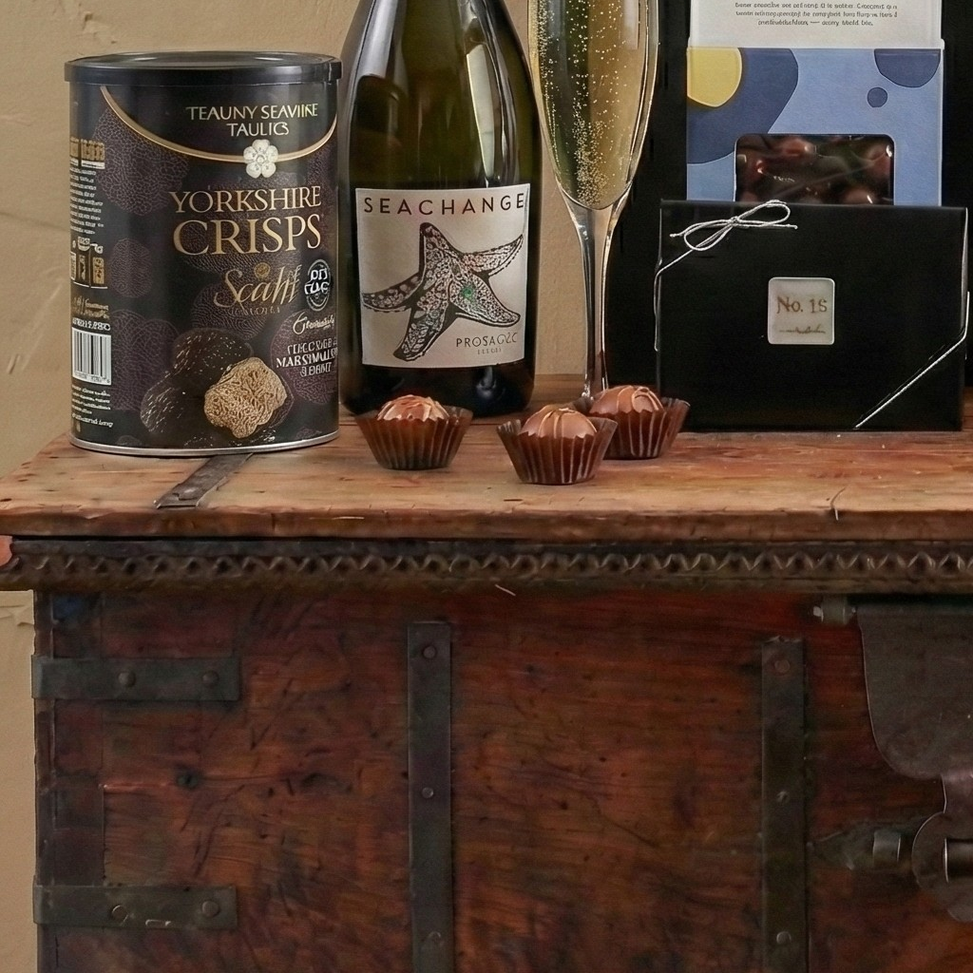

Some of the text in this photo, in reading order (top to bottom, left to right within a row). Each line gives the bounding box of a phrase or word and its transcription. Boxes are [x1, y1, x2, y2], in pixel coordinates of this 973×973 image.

[169, 185, 322, 214] YORKSHIRE
[363, 192, 525, 216] SEACHANGE
[172, 213, 322, 256] CRISPS
